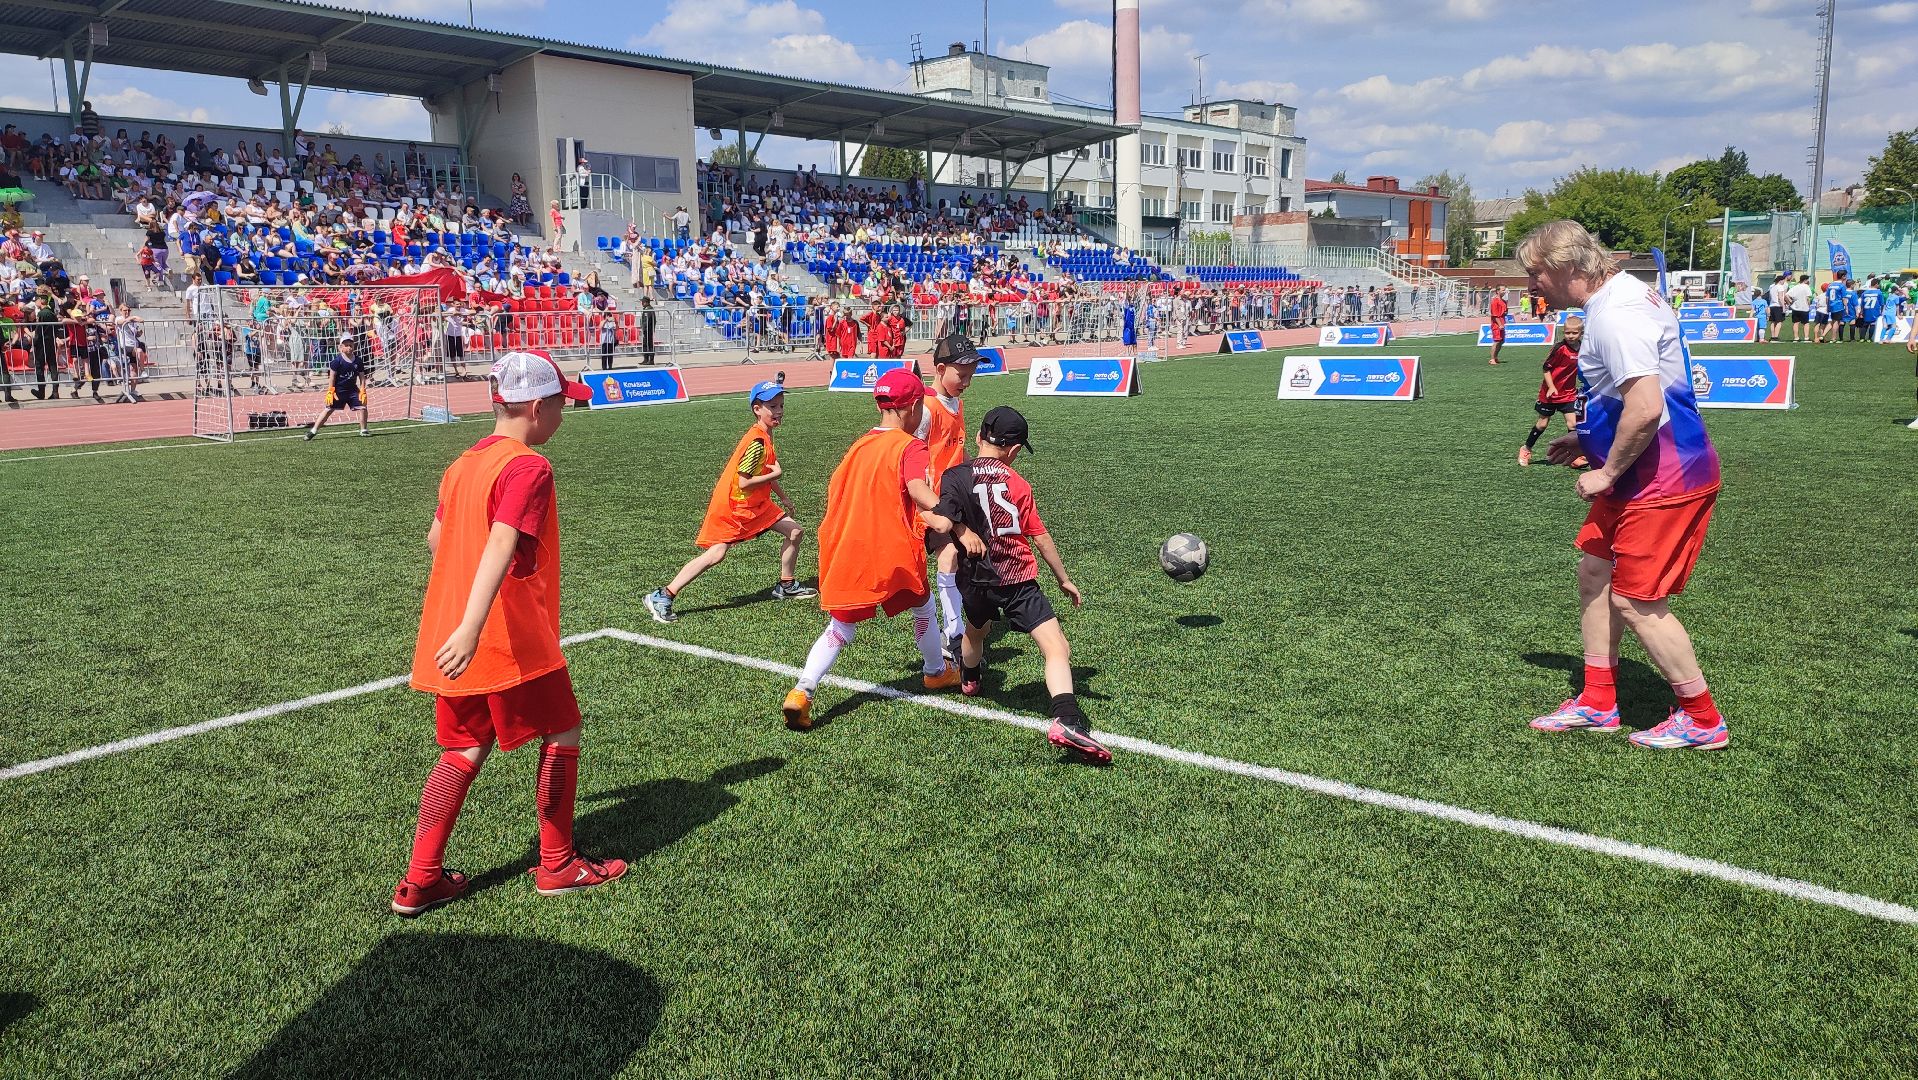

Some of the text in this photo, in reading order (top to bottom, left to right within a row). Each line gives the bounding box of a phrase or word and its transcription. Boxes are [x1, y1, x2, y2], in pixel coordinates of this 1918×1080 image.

[1863, 296, 1878, 309] 27
[623, 380, 652, 389] Команда
[625, 388, 666, 399] Губернатора
[972, 482, 1022, 537] 15
